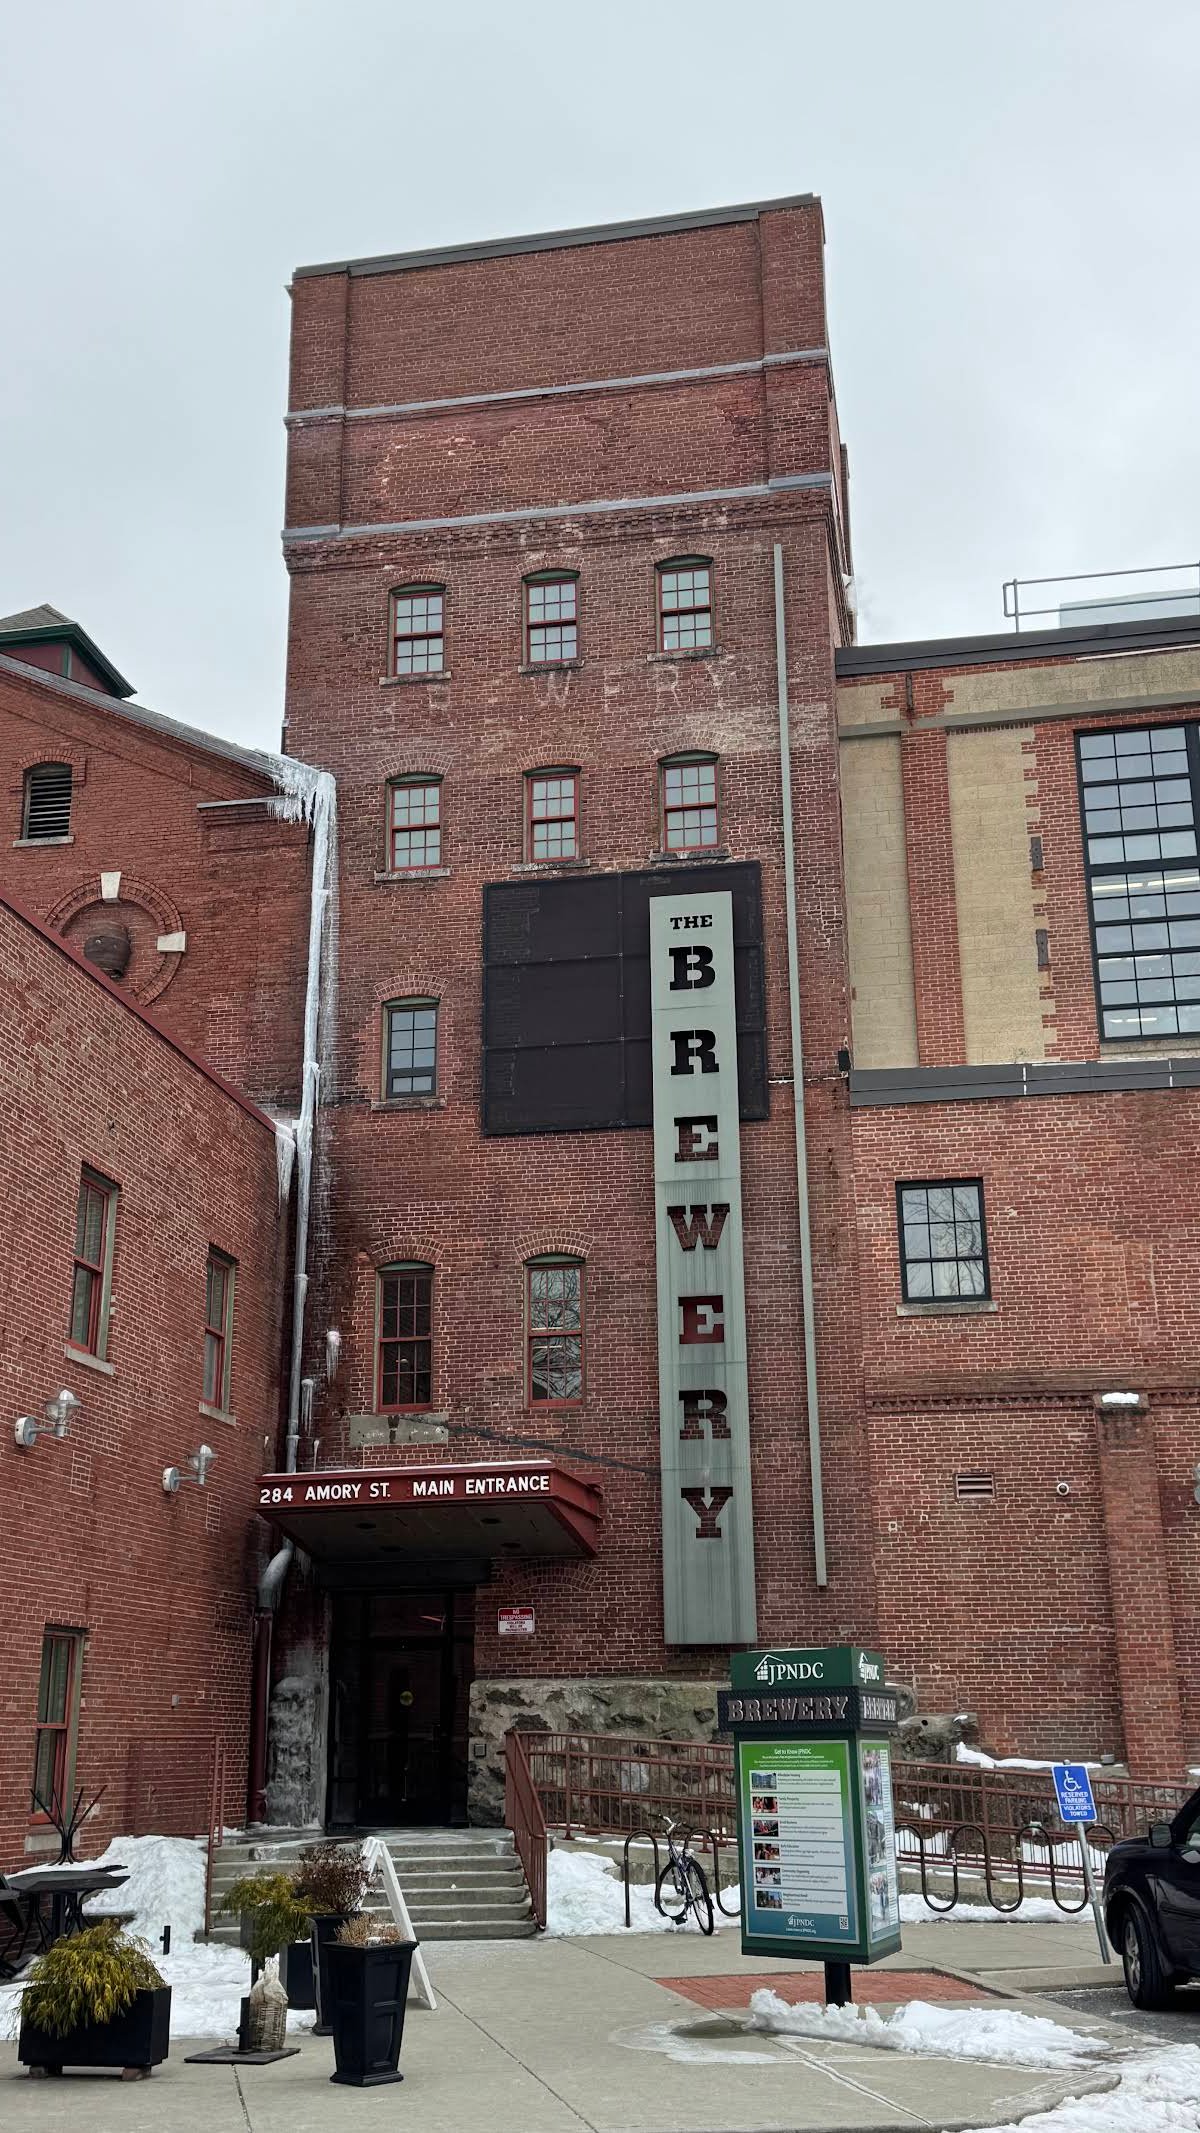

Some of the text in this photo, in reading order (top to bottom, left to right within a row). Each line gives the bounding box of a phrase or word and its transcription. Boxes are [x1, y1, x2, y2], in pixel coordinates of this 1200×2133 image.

[670, 914, 713, 930] THE
[667, 945, 734, 1539] BREWERY
[259, 1475, 550, 1504] 284 AMORY ST. MAIN ENTRANCE
[768, 1662, 824, 1686] JPNDC
[727, 1696, 849, 1722] BREWERY
[863, 1696, 896, 1721] BREWERY
[793, 1919, 815, 1927] JPNDC
